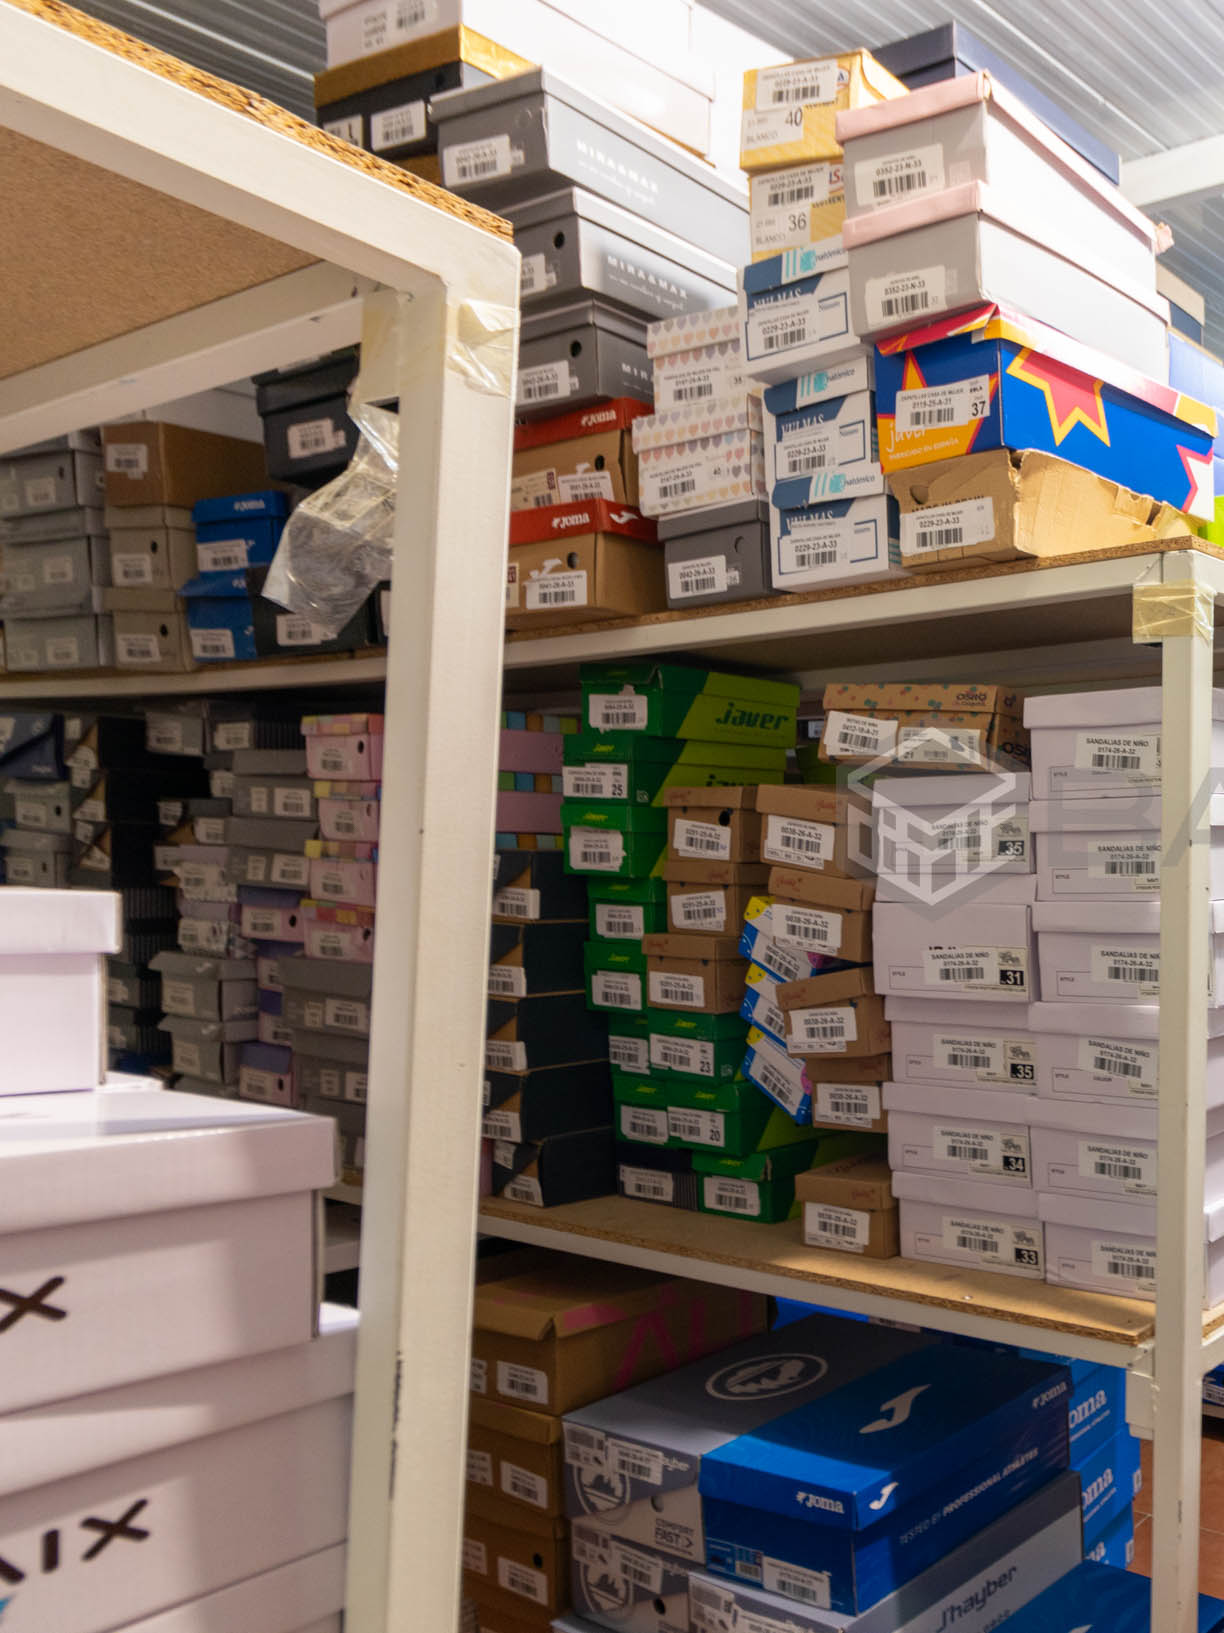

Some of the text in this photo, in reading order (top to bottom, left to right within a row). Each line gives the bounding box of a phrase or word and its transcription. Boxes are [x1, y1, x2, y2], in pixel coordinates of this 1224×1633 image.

[785, 108, 802, 127] 40
[788, 213, 807, 230] 36
[971, 401, 986, 417] 37
[1086, 738, 1122, 747] SANDALIAS
[612, 783, 623, 796] 25
[1006, 841, 1023, 856] 35
[1098, 845, 1134, 853] SANDALIAS
[1136, 845, 1144, 853] DE
[1003, 972, 1022, 986] 31
[700, 1061, 712, 1074] 23
[1014, 1064, 1034, 1079] 35
[709, 1130, 721, 1142] 20
[1007, 1157, 1024, 1171] 34
[1020, 1250, 1037, 1265] 33
[943, 1472, 1001, 1517] PROFESSIONAL
[805, 1494, 845, 1514] Joma
